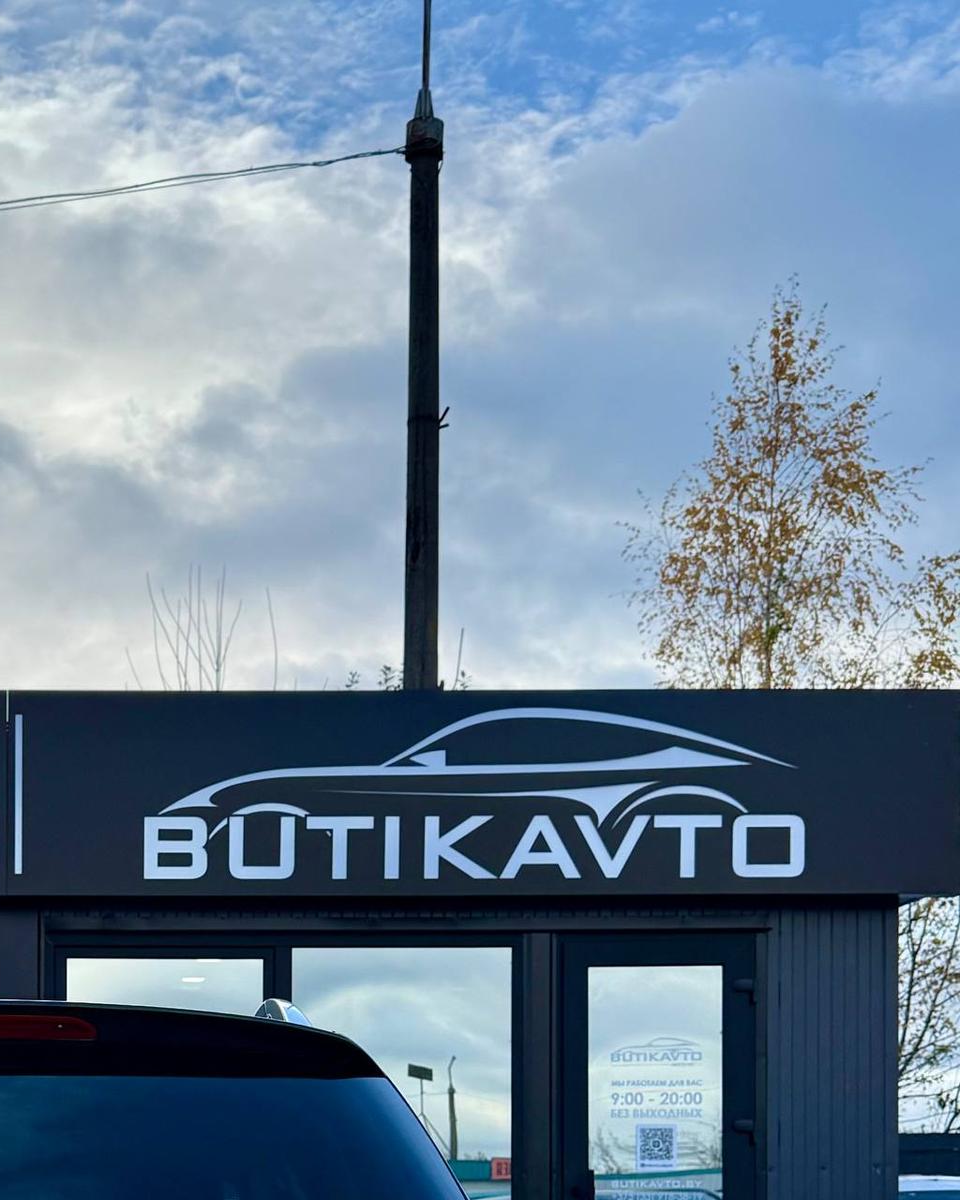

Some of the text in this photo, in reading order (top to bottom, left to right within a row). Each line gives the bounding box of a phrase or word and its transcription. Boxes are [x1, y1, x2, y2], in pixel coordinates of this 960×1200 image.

[143, 813, 806, 881] BUTIKAVTO
[610, 1051, 703, 1063] BUTIKAVTO
[611, 1092, 644, 1105] 9:00
[659, 1091, 703, 1105] 20:00
[610, 1108, 702, 1119] БЕЗ ВЫХОДНЫХ
[611, 1180, 703, 1189] BUTIKAVTO.BY
